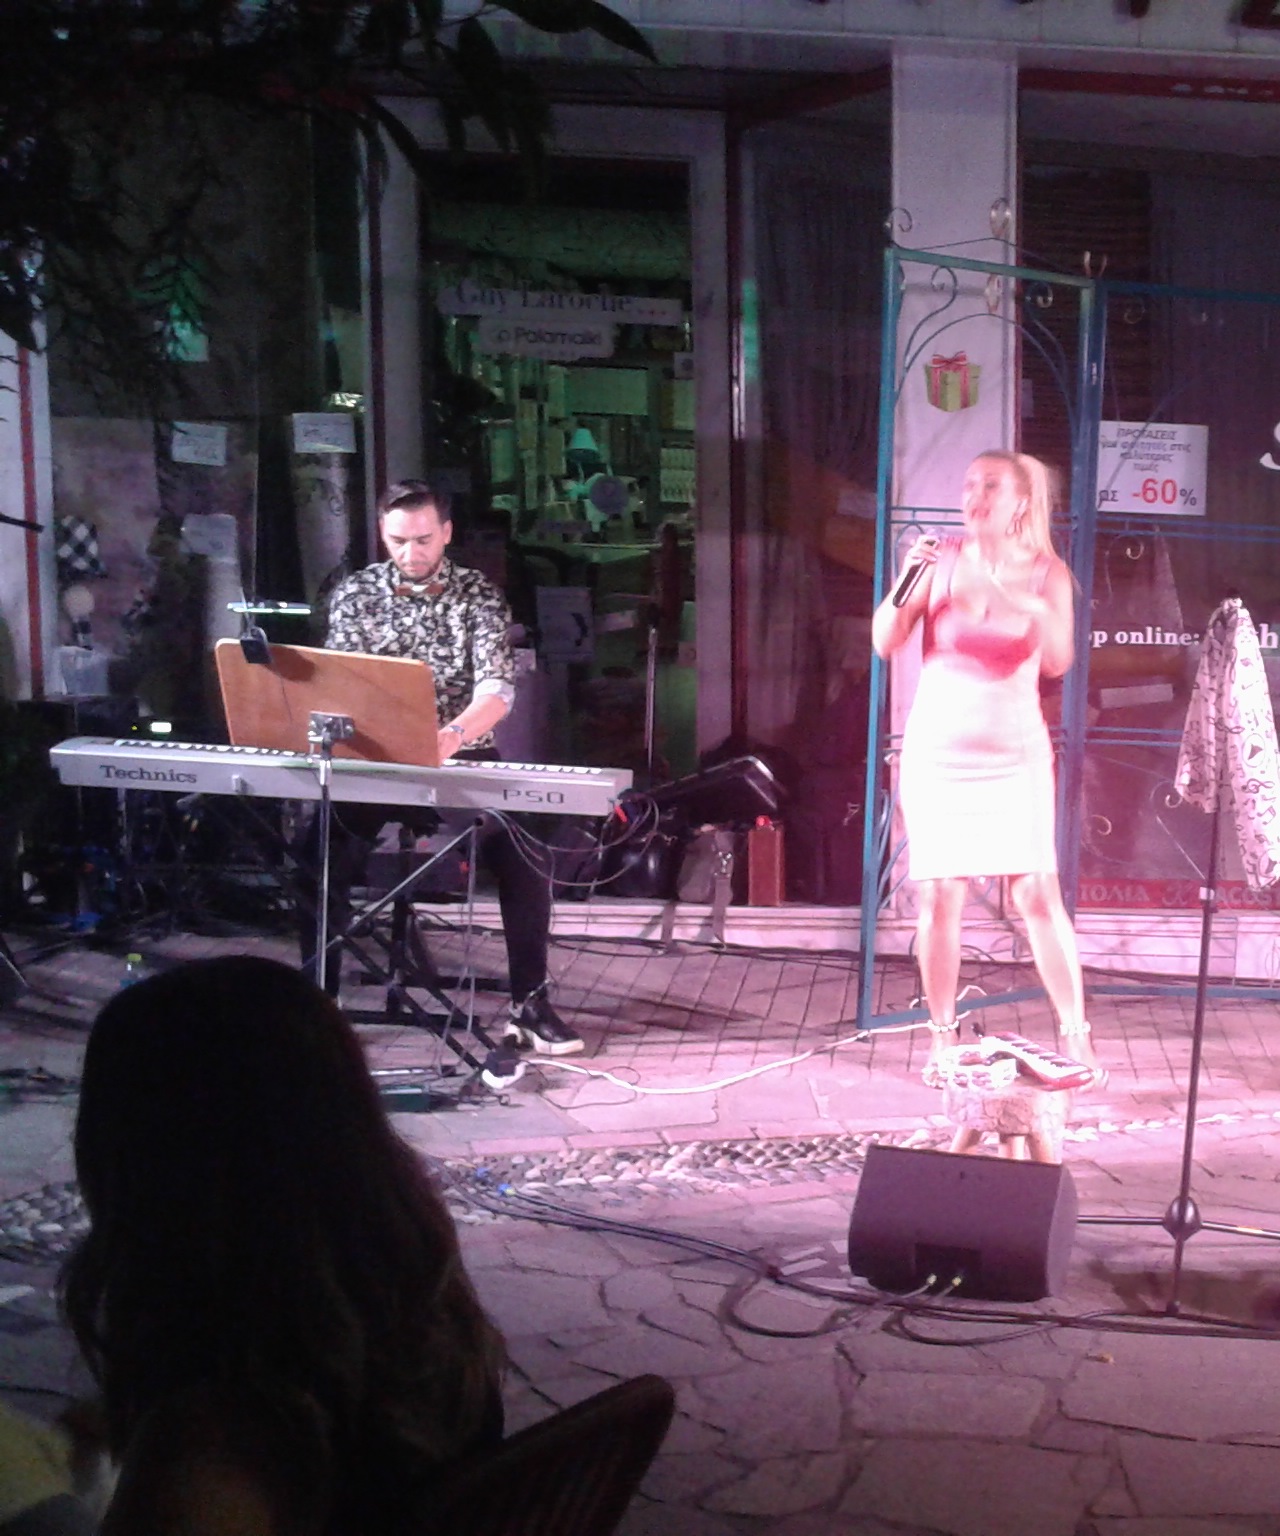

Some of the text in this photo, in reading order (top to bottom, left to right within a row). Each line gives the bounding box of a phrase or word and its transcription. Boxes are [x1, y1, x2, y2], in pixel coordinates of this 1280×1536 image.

[456, 278, 631, 314] Guy Laroche
[1115, 627, 1200, 646] online:
[99, 763, 198, 785] Technics
